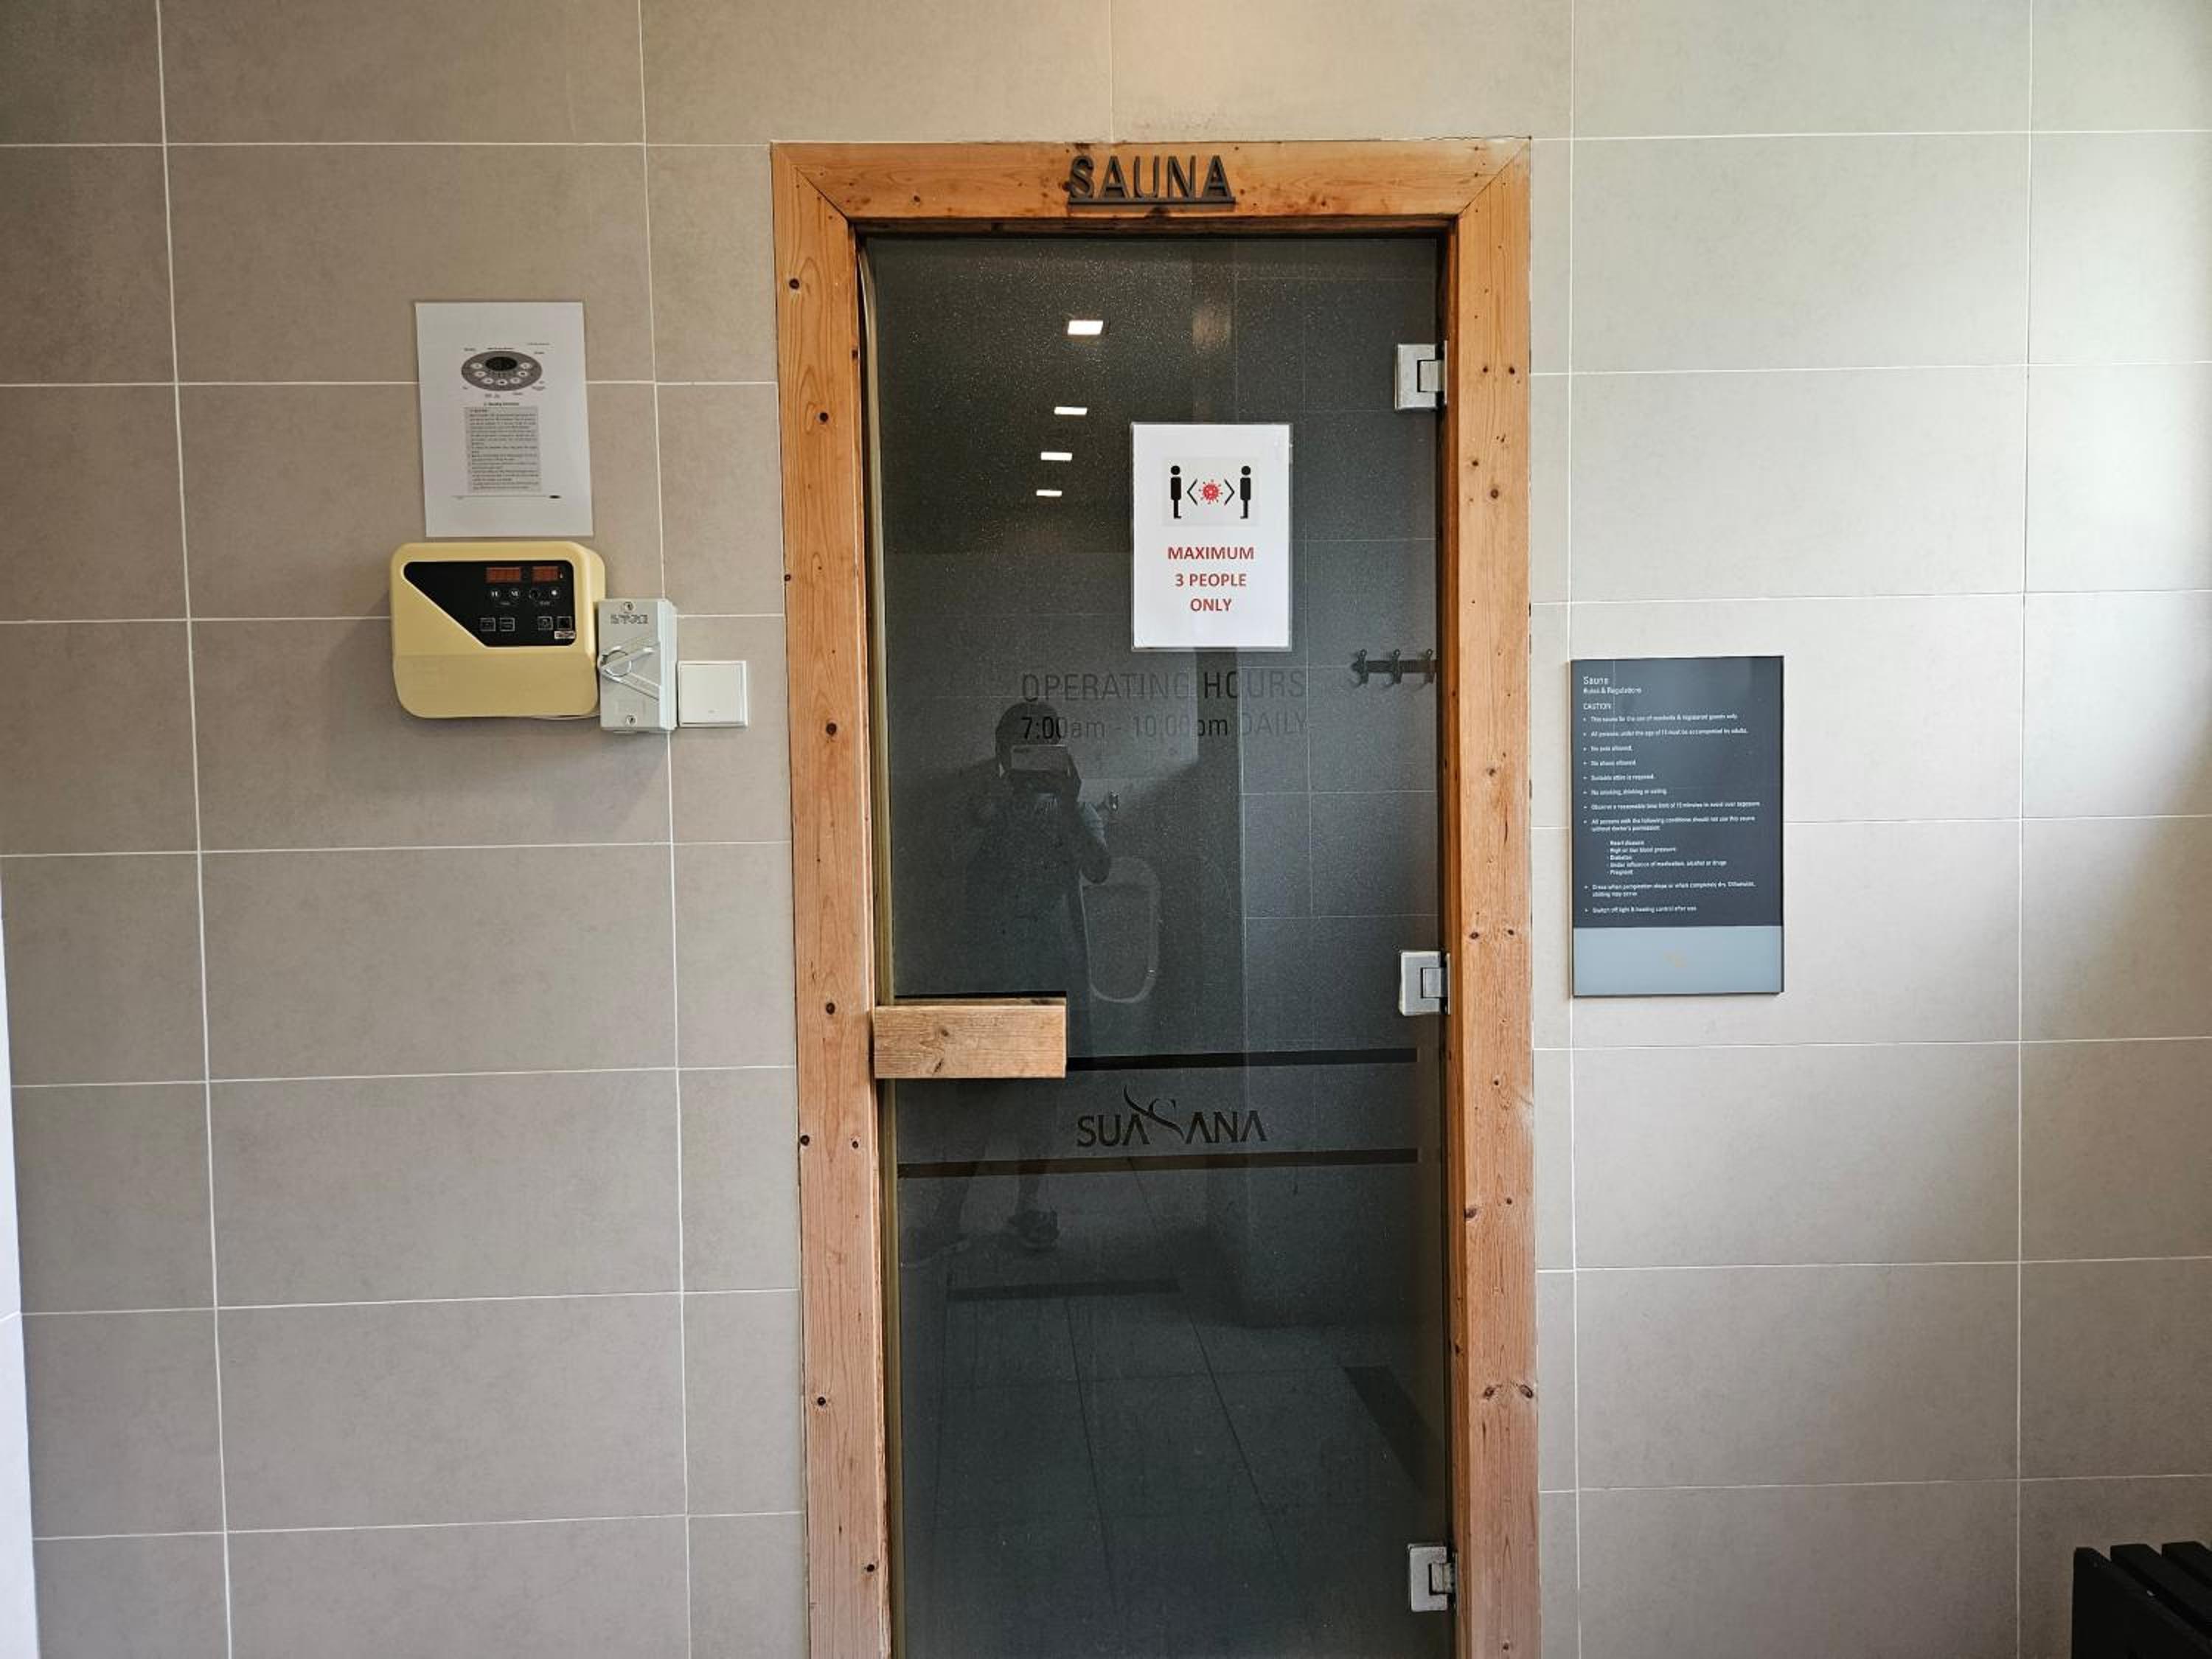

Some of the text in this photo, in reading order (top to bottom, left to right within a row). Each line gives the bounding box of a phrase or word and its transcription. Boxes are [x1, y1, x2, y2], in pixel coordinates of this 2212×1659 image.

[1069, 154, 1234, 201] SAUNA
[1167, 546, 1255, 560] MAXIMUM
[1175, 573, 1248, 587] 3 PEOPLE
[1190, 597, 1233, 612] ONLY
[1021, 669, 1306, 702] OPERATING HOURS
[1020, 716, 1105, 740] 7:00am
[1241, 712, 1309, 736] DAILY
[1076, 1084, 1269, 1147] SUASANA
